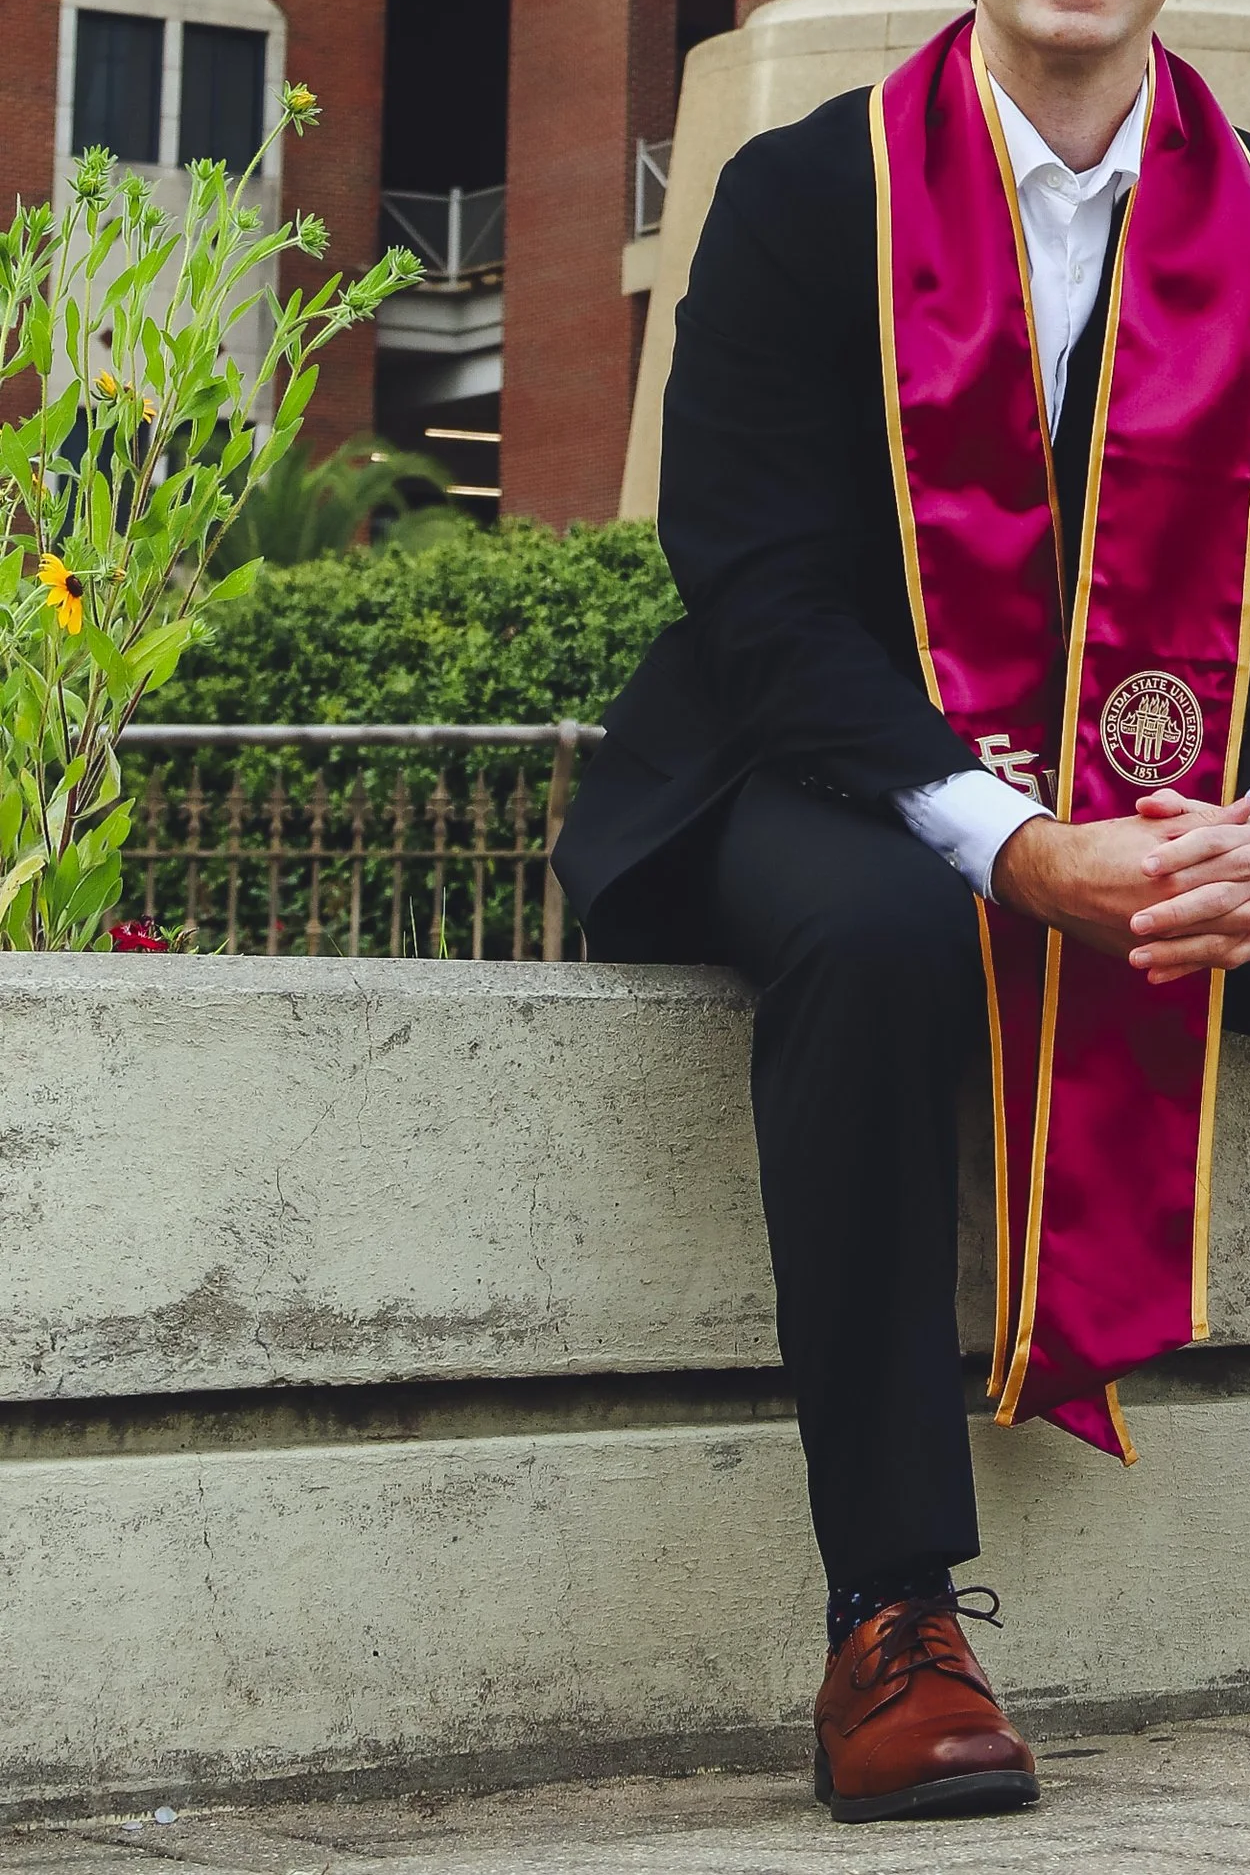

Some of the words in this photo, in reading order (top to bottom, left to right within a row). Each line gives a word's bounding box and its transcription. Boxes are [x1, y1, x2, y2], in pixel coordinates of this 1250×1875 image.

[1106, 691, 1132, 752] FLORIDA
[1131, 677, 1168, 693] STATE
[1169, 685, 1196, 765] UNIVERSITY
[1133, 765, 1160, 780] 1851
